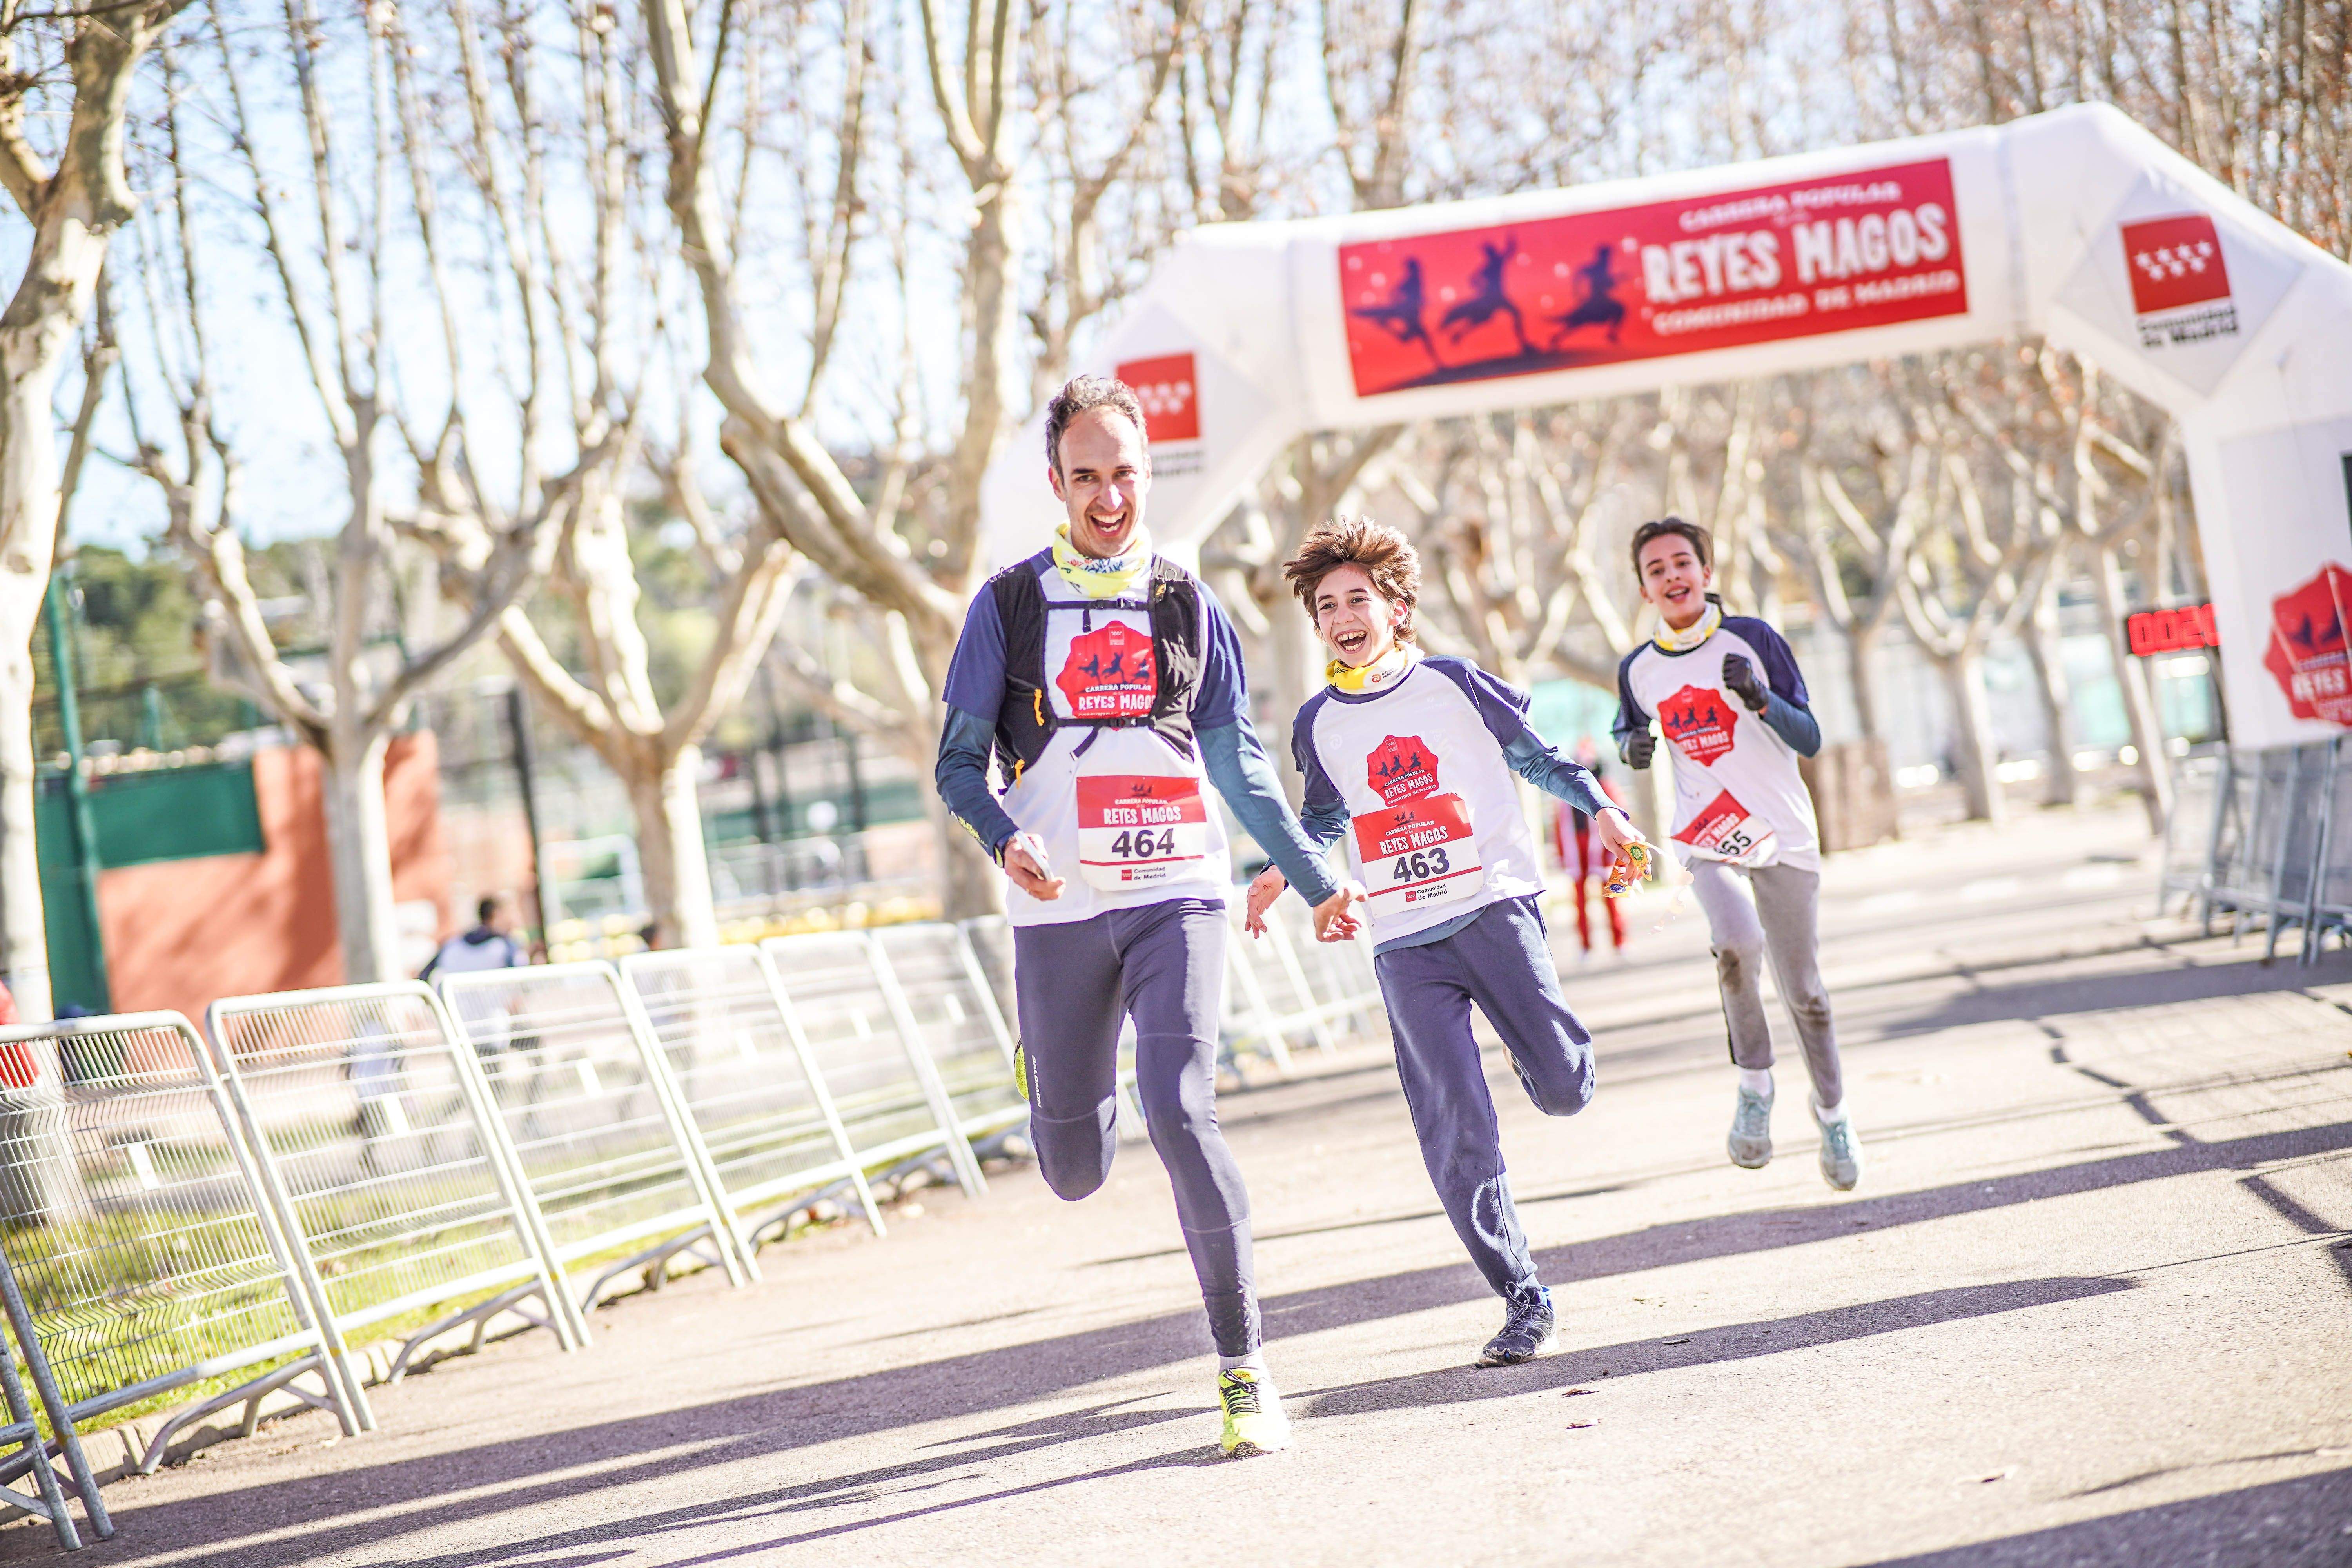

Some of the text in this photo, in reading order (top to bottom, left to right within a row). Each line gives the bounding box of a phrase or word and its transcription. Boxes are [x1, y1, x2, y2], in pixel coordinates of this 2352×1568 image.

[1679, 194, 1788, 232] CARRERA
[1790, 181, 1902, 209] POPULAR
[1641, 202, 1950, 304] REYES MAGOS
[1653, 269, 1960, 336] COMUNIDAD DE MADRID
[1085, 684, 1119, 692] CARRERA
[1078, 695, 1115, 710] REYES
[1384, 773, 1434, 799] REYES MAGOS
[1385, 775, 1405, 787] CARRERA
[1404, 769, 1425, 778] POPULAR
[1388, 793, 1412, 804] COMUNIDAD
[1419, 784, 1436, 793] MADRID
[1103, 806, 1182, 825] REYES MAGOS
[1385, 820, 1435, 836] CARRERA POPULAR
[1112, 828, 1174, 858] 464
[1379, 826, 1448, 855] REYES MAGOS
[1394, 848, 1450, 882] 463
[1417, 884, 1446, 894] Comunidad
[1428, 889, 1448, 898] Madrid
[1032, 1055, 1042, 1108] SALOMON
